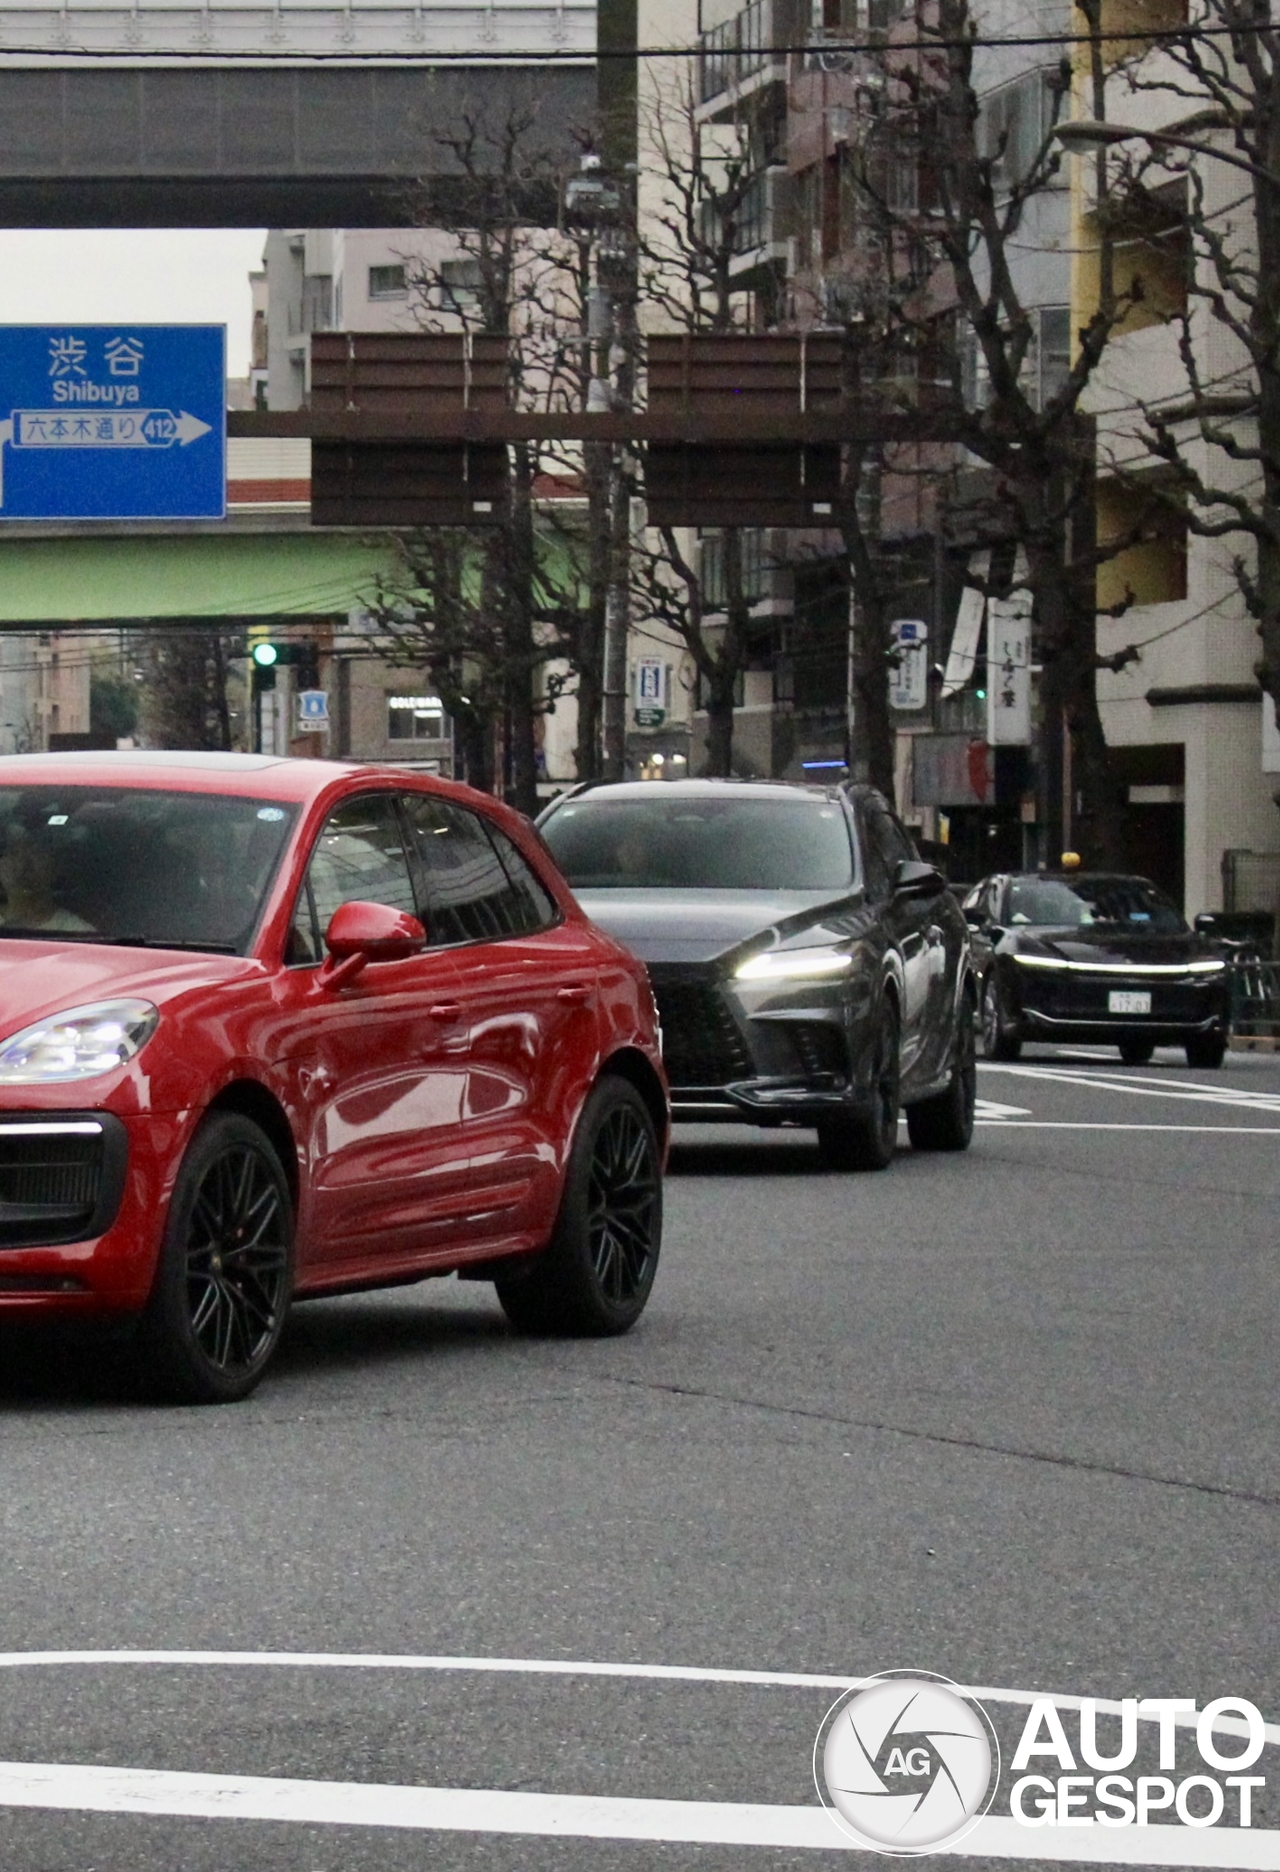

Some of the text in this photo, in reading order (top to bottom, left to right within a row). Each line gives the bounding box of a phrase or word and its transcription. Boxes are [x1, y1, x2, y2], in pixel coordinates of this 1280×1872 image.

[47, 336, 146, 377] 渋谷
[52, 380, 140, 406] Shibuya
[26, 416, 174, 442] 六本木通り 412
